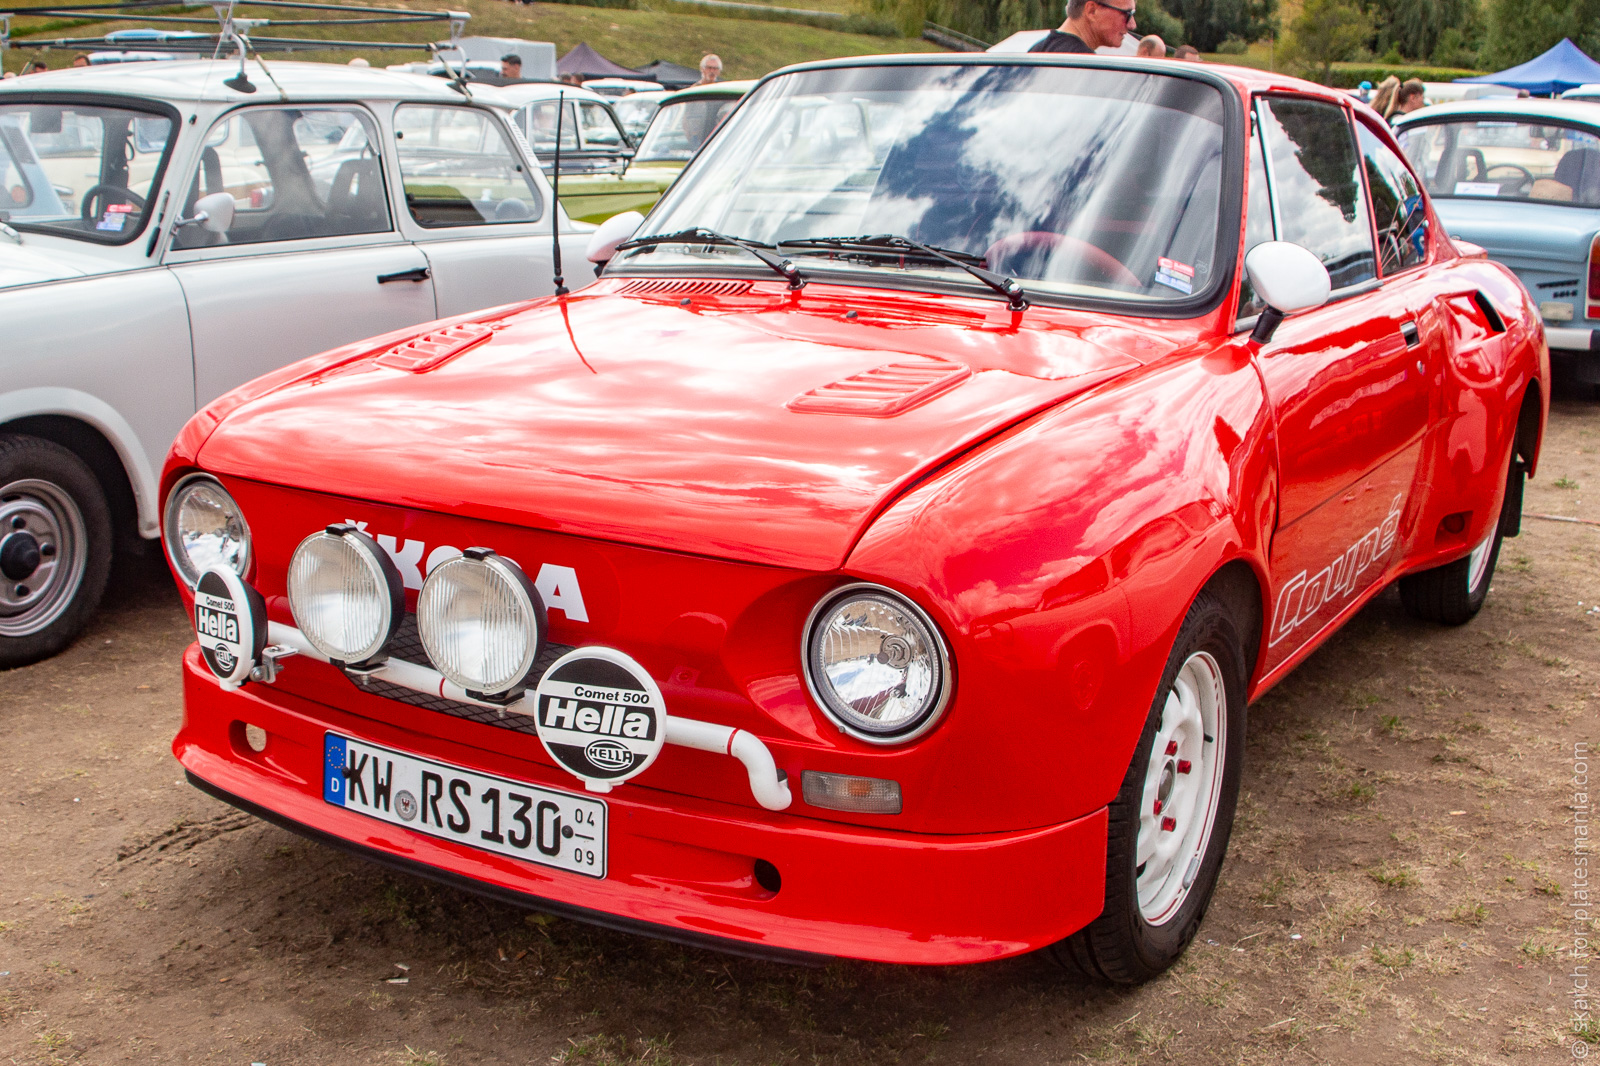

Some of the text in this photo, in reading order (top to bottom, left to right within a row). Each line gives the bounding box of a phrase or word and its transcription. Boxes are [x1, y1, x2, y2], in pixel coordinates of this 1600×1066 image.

[1268, 492, 1402, 649] Coupé
[205, 596, 235, 612] Comet 500
[198, 606, 238, 642] Hella
[574, 686, 650, 704] Comet 500
[544, 697, 650, 739] Hella
[589, 748, 633, 763] HELLA
[331, 777, 340, 793] D
[350, 749, 561, 857] KW RS 130
[575, 808, 595, 827] 04
[574, 847, 594, 866] 09
